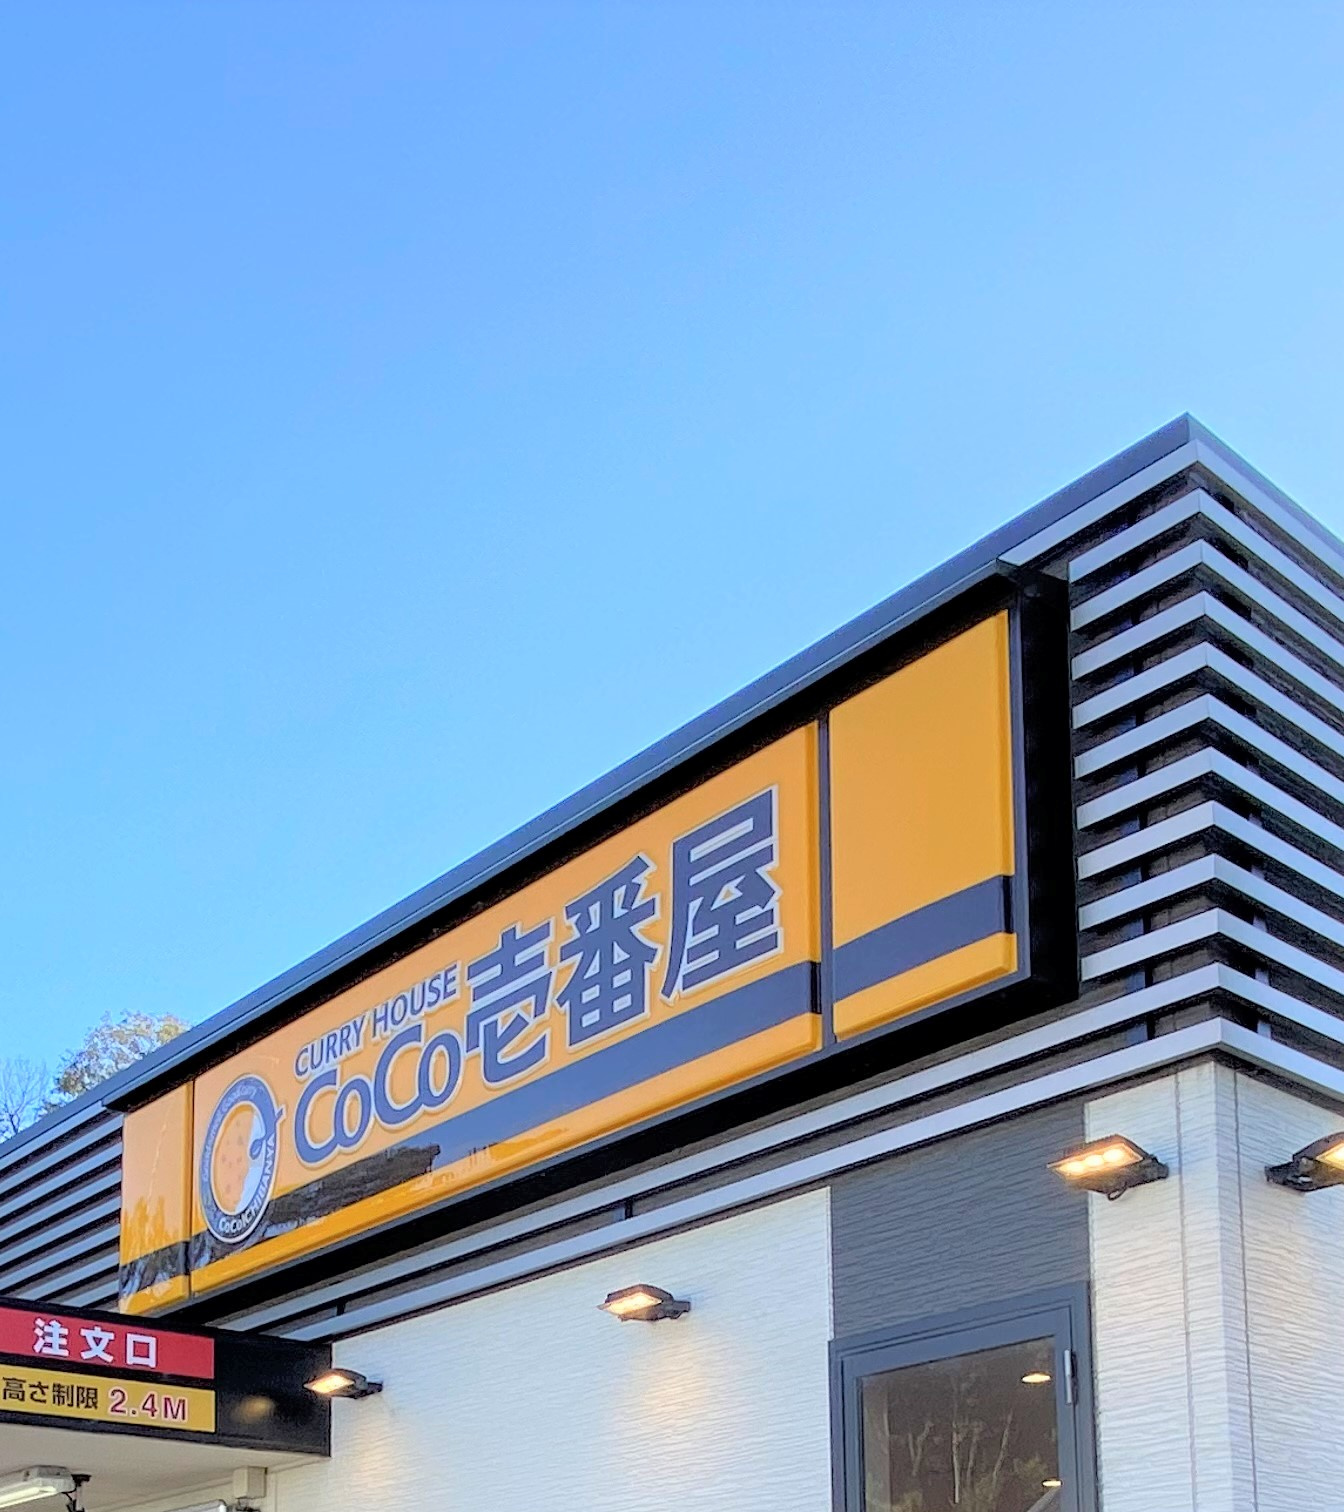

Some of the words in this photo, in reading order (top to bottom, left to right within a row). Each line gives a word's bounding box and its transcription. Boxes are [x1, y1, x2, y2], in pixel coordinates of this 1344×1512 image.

[294, 1016, 366, 1079] CURRY
[370, 965, 459, 1038] HOUSE
[31, 1318, 157, 1368] 注文口
[2, 1376, 99, 1410] 高さ制限
[109, 1388, 187, 1422] 2.4M
